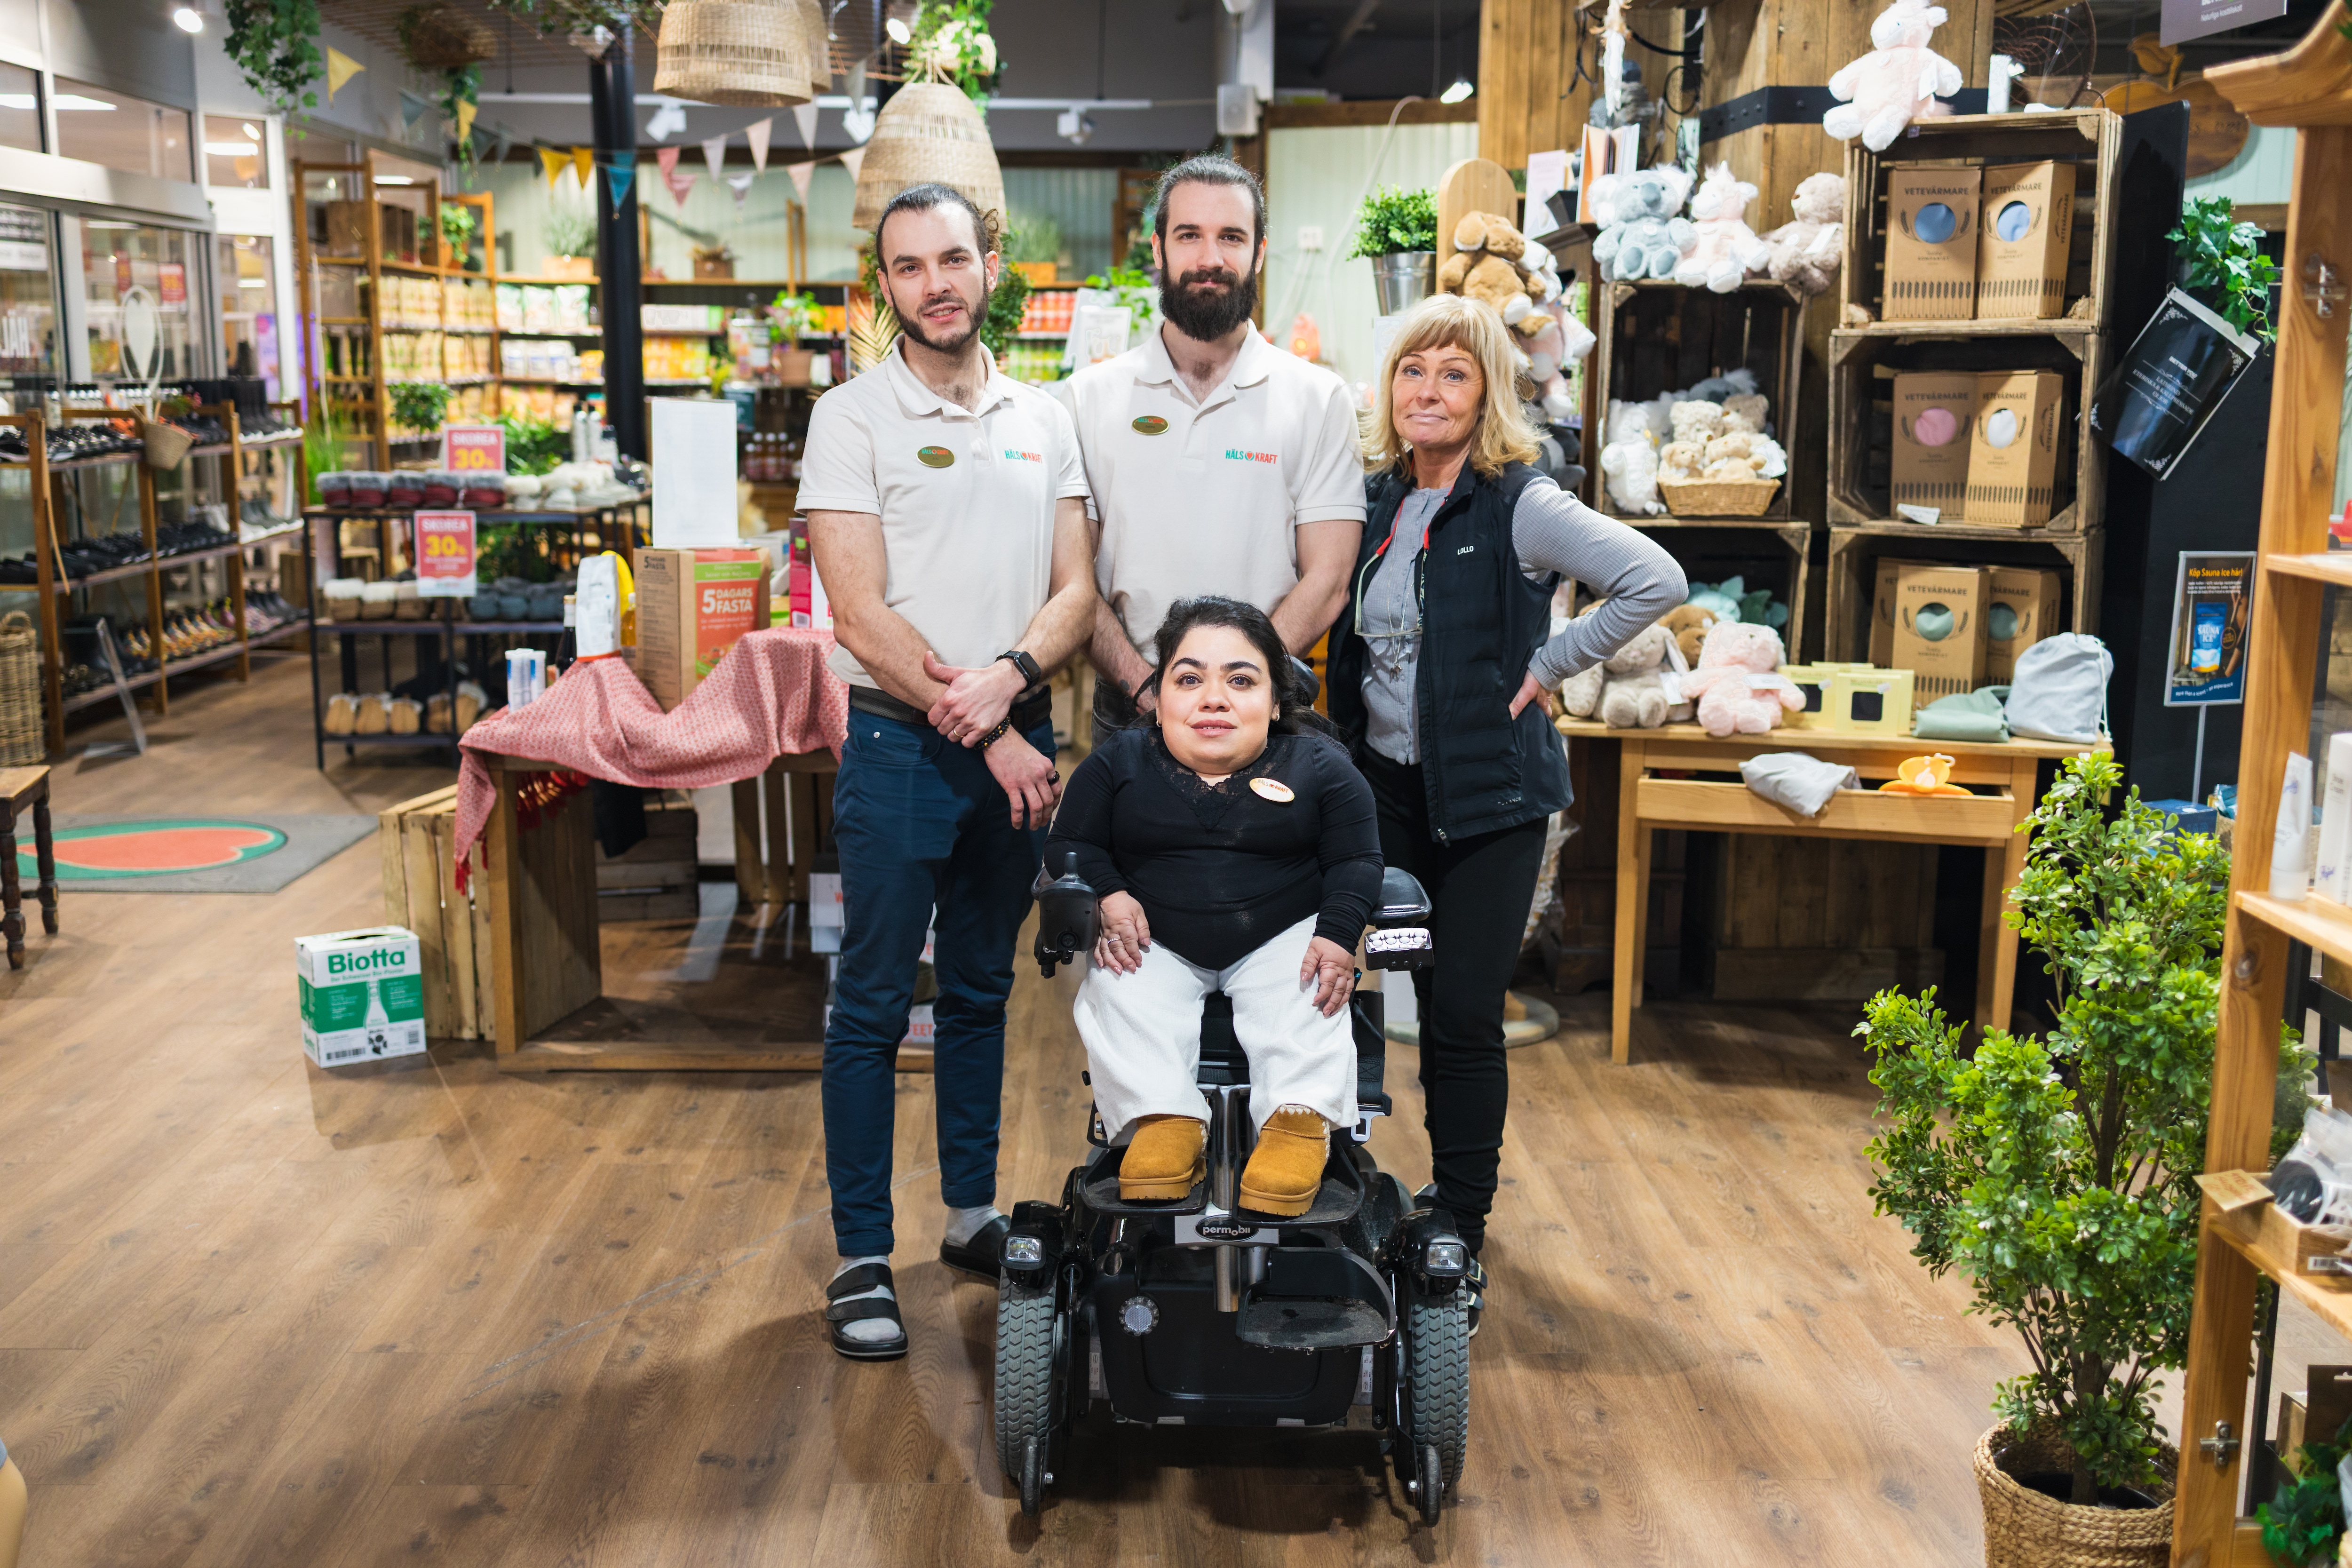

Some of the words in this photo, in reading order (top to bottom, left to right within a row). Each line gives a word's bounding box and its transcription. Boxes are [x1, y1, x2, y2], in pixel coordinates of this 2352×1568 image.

[1905, 185, 1969, 196] VETEVÄRMARE
[1991, 182, 2042, 194] VETEVÄRMARE
[2169, 355, 2188, 372] BETTER
[2186, 368, 2198, 379] YOU
[1905, 392, 1969, 401] VETEVÄRMARE
[1983, 391, 2028, 401] VETEVÄRMARE
[1004, 449, 1020, 460] HÄLS
[1027, 452, 1042, 464] KRAFT
[1225, 449, 1244, 460] HÄLS
[1255, 452, 1278, 464] KRAFT
[1457, 545, 1474, 555] LOLLO
[644, 556, 649, 568] 5
[2189, 568, 2201, 579] Köp
[2201, 568, 2220, 577] Sauna
[2221, 568, 2230, 577] Ice
[2231, 567, 2243, 577] här!
[1907, 585, 1968, 597] VETEVÄRMARE
[701, 589, 716, 614] 5
[716, 587, 754, 599] DAGARS
[716, 598, 753, 614] FASTA
[2198, 625, 2219, 635] SAUNA
[2214, 682, 2233, 690] experience
[1275, 785, 1289, 793] KRAFT
[328, 948, 405, 974] Biotta
[1203, 1224, 1251, 1236] permobil
